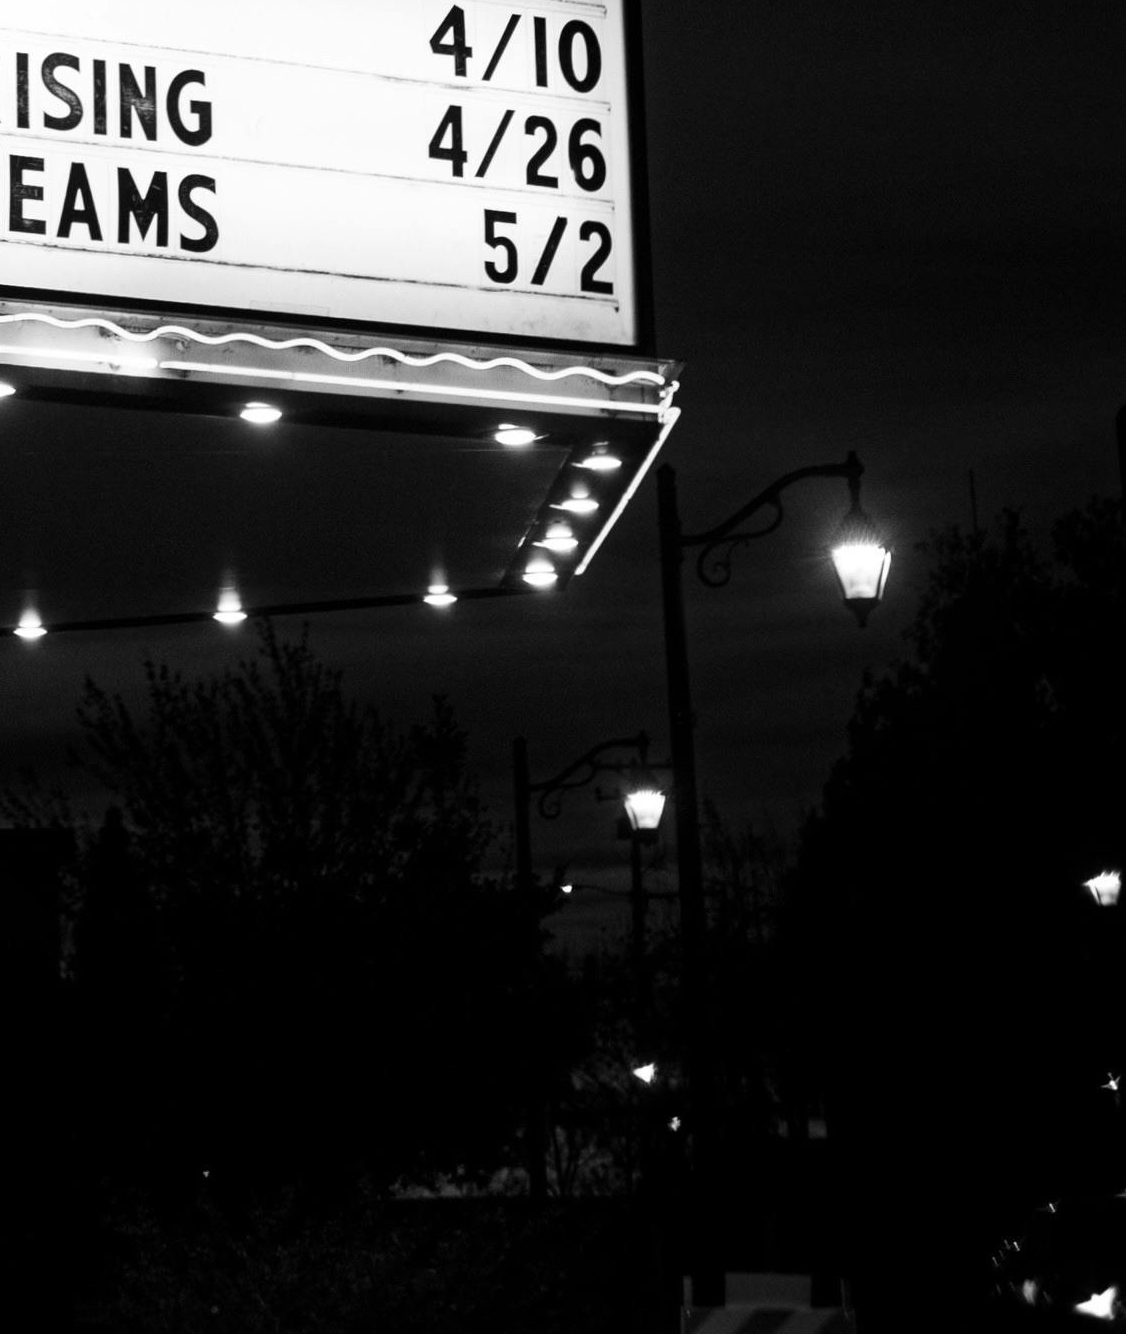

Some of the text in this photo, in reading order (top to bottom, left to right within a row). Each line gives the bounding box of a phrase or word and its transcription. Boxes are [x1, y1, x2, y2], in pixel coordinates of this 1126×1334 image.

[429, 4, 602, 95] 4/10
[428, 105, 607, 193] 4/26
[484, 208, 614, 297] 5/2
